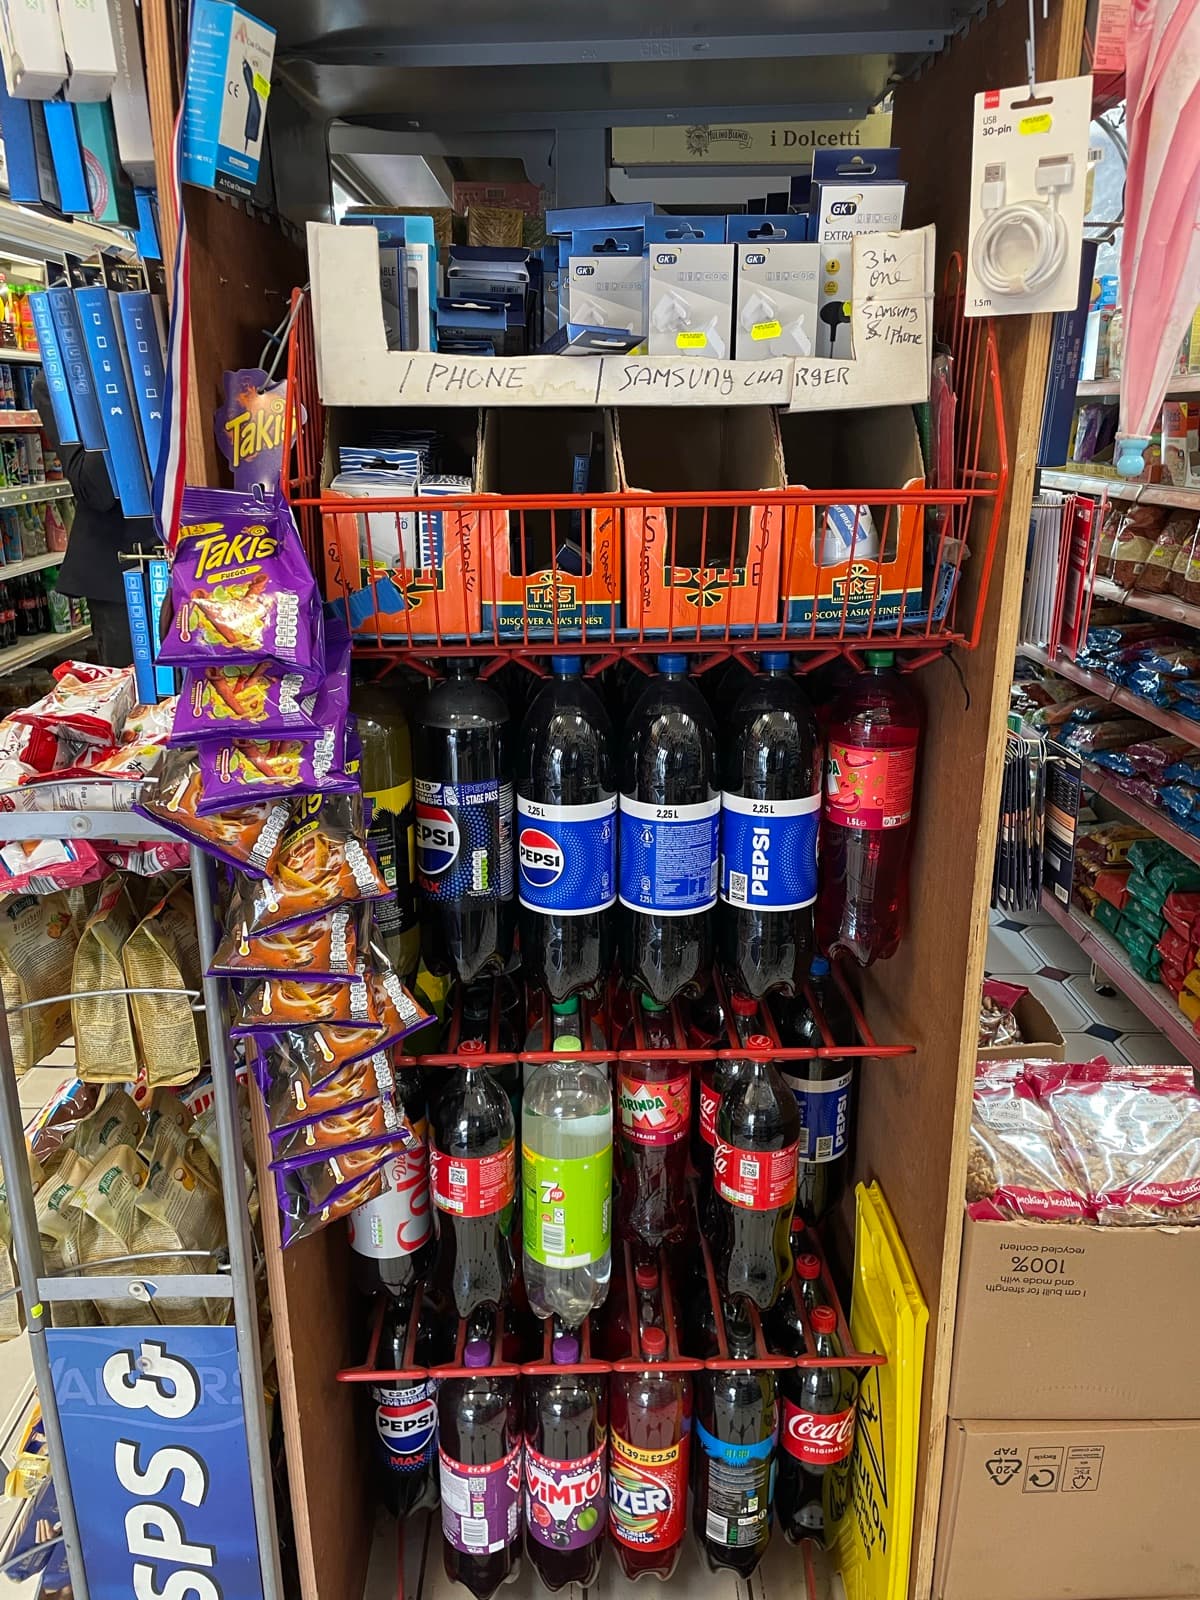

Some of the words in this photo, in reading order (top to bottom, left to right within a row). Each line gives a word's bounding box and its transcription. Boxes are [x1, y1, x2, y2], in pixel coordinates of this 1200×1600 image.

[983, 116, 997, 125] USB
[982, 124, 1012, 136] 30-pin
[770, 130, 777, 147] i
[784, 130, 861, 146] Dolcetti
[833, 203, 855, 214] GKT
[824, 230, 853, 241] EXTRA
[657, 254, 676, 264] GKT
[747, 254, 765, 264] GKT
[863, 250, 879, 269] 3
[576, 267, 593, 276] GKT
[974, 298, 992, 307] 1.5m
[426, 363, 527, 393] PHONE
[195, 534, 279, 579] Takis
[221, 569, 246, 580] FUEGO
[836, 578, 876, 596] TRS
[530, 585, 572, 603] TRS
[499, 616, 544, 626] DISCOVER
[546, 616, 573, 626] AIA'S
[465, 792, 484, 806] STAGE
[485, 790, 498, 803] PASS
[527, 804, 541, 816] 2,25
[541, 807, 546, 817] L
[752, 803, 769, 814] 2,25
[770, 804, 775, 814] L
[656, 809, 673, 820] 2,25
[674, 810, 679, 819] L
[520, 847, 561, 868] PEPSI
[752, 827, 771, 897] PEPSI
[835, 1094, 848, 1148] PEPSI
[392, 1155, 407, 1181] Die
[1049, 1196, 1083, 1211] healthy
[1000, 1243, 1039, 1252] content
[1041, 1245, 1085, 1255] recycled
[1011, 1256, 1065, 1274] 100%
[1000, 1276, 1020, 1285] with
[1022, 1277, 1053, 1286] made
[1055, 1279, 1075, 1287] and
[985, 1284, 1025, 1295] strength
[1026, 1287, 1040, 1296] for
[1042, 1288, 1063, 1297] built
[1065, 1289, 1081, 1297] am
[1082, 1289, 1087, 1298] I
[388, 1388, 416, 1398] £2.19
[378, 1409, 434, 1433] PEPSI
[617, 1442, 639, 1460] £1.39
[651, 1449, 677, 1463] £2.50
[803, 1445, 843, 1455] ORIGINAL
[993, 1447, 1018, 1456] PAP
[390, 1453, 425, 1467] MAX
[539, 1456, 562, 1469] £1.69
[569, 1456, 593, 1469] £1.69
[1034, 1453, 1057, 1461] Recycle
[467, 1464, 492, 1474] £1.69
[995, 1464, 1012, 1475] 20
